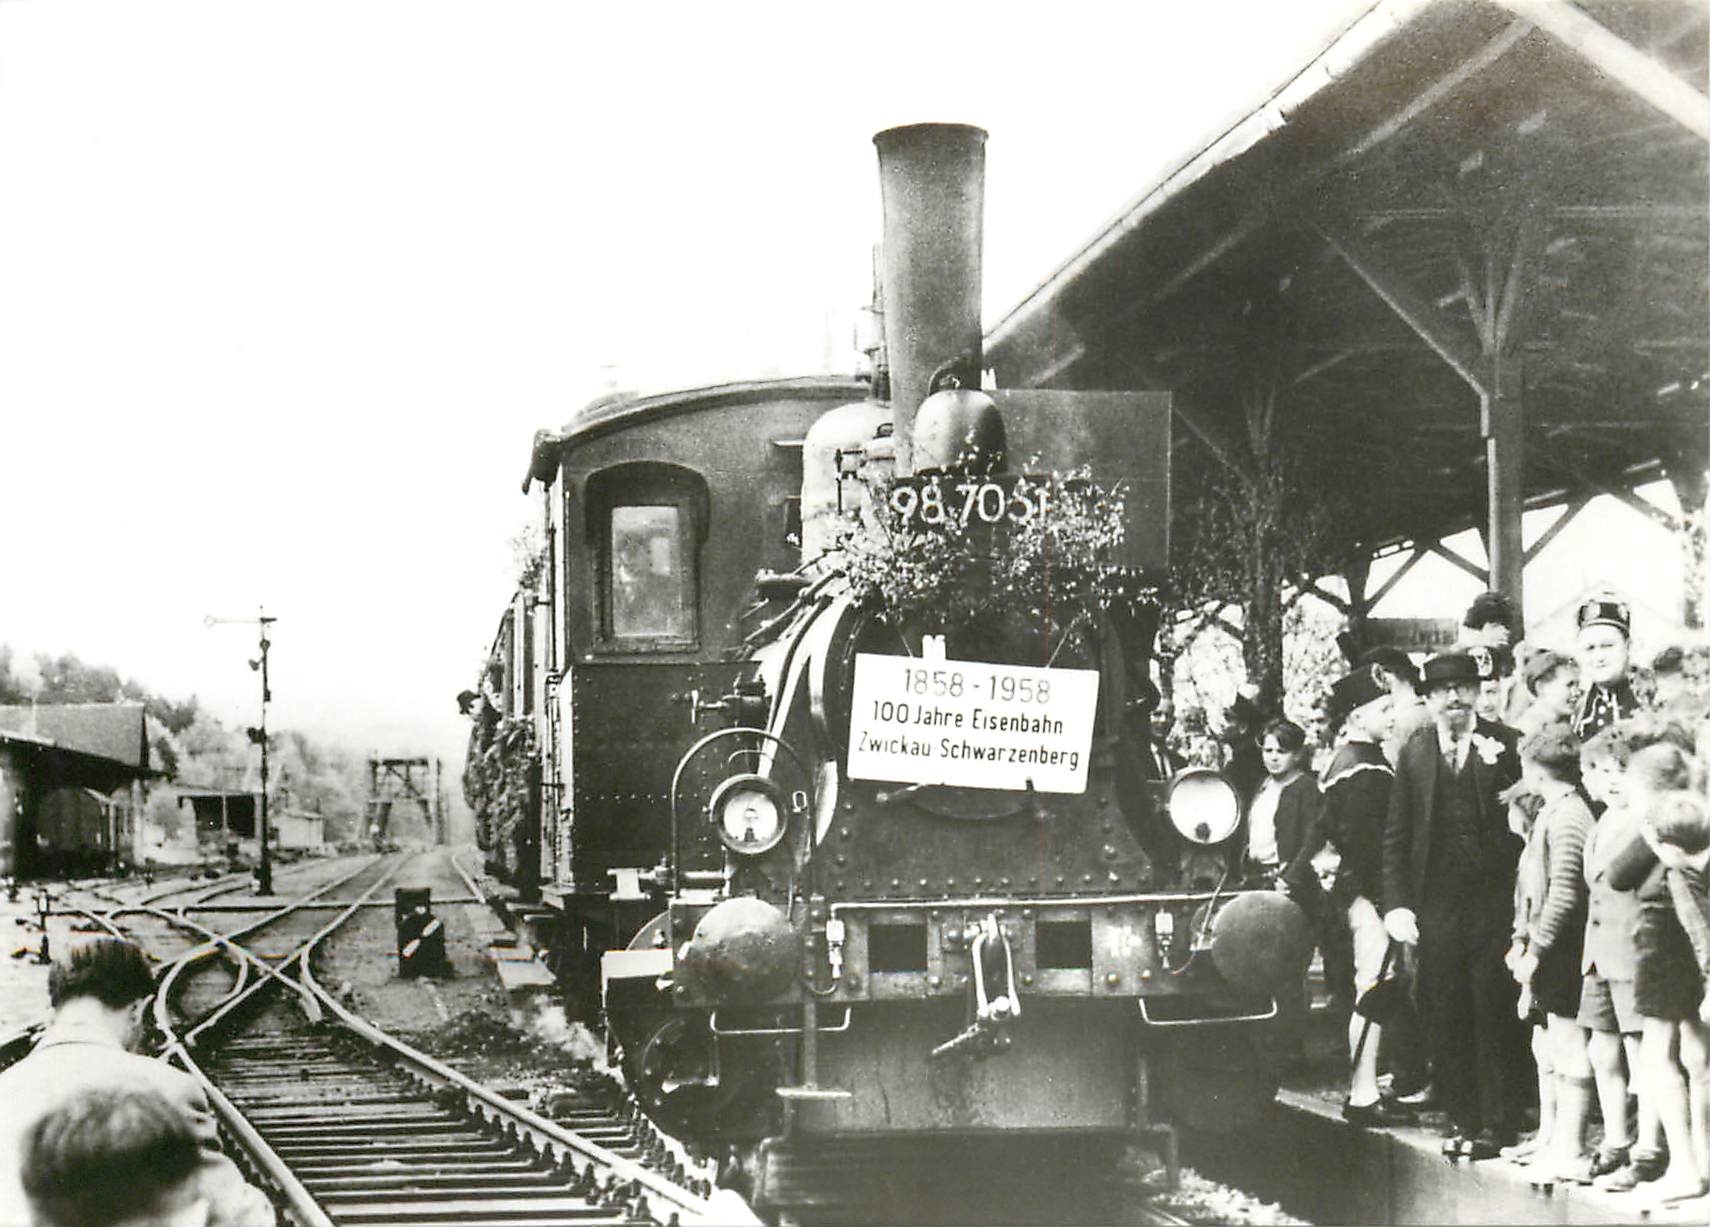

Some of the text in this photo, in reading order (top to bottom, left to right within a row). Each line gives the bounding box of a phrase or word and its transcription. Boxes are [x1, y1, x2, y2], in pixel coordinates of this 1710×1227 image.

[889, 483, 1050, 529] 98 7051
[904, 668, 964, 698] 1858
[989, 674, 1051, 704] 1958
[873, 699, 1064, 735] 100 Jahre Eisenbahn
